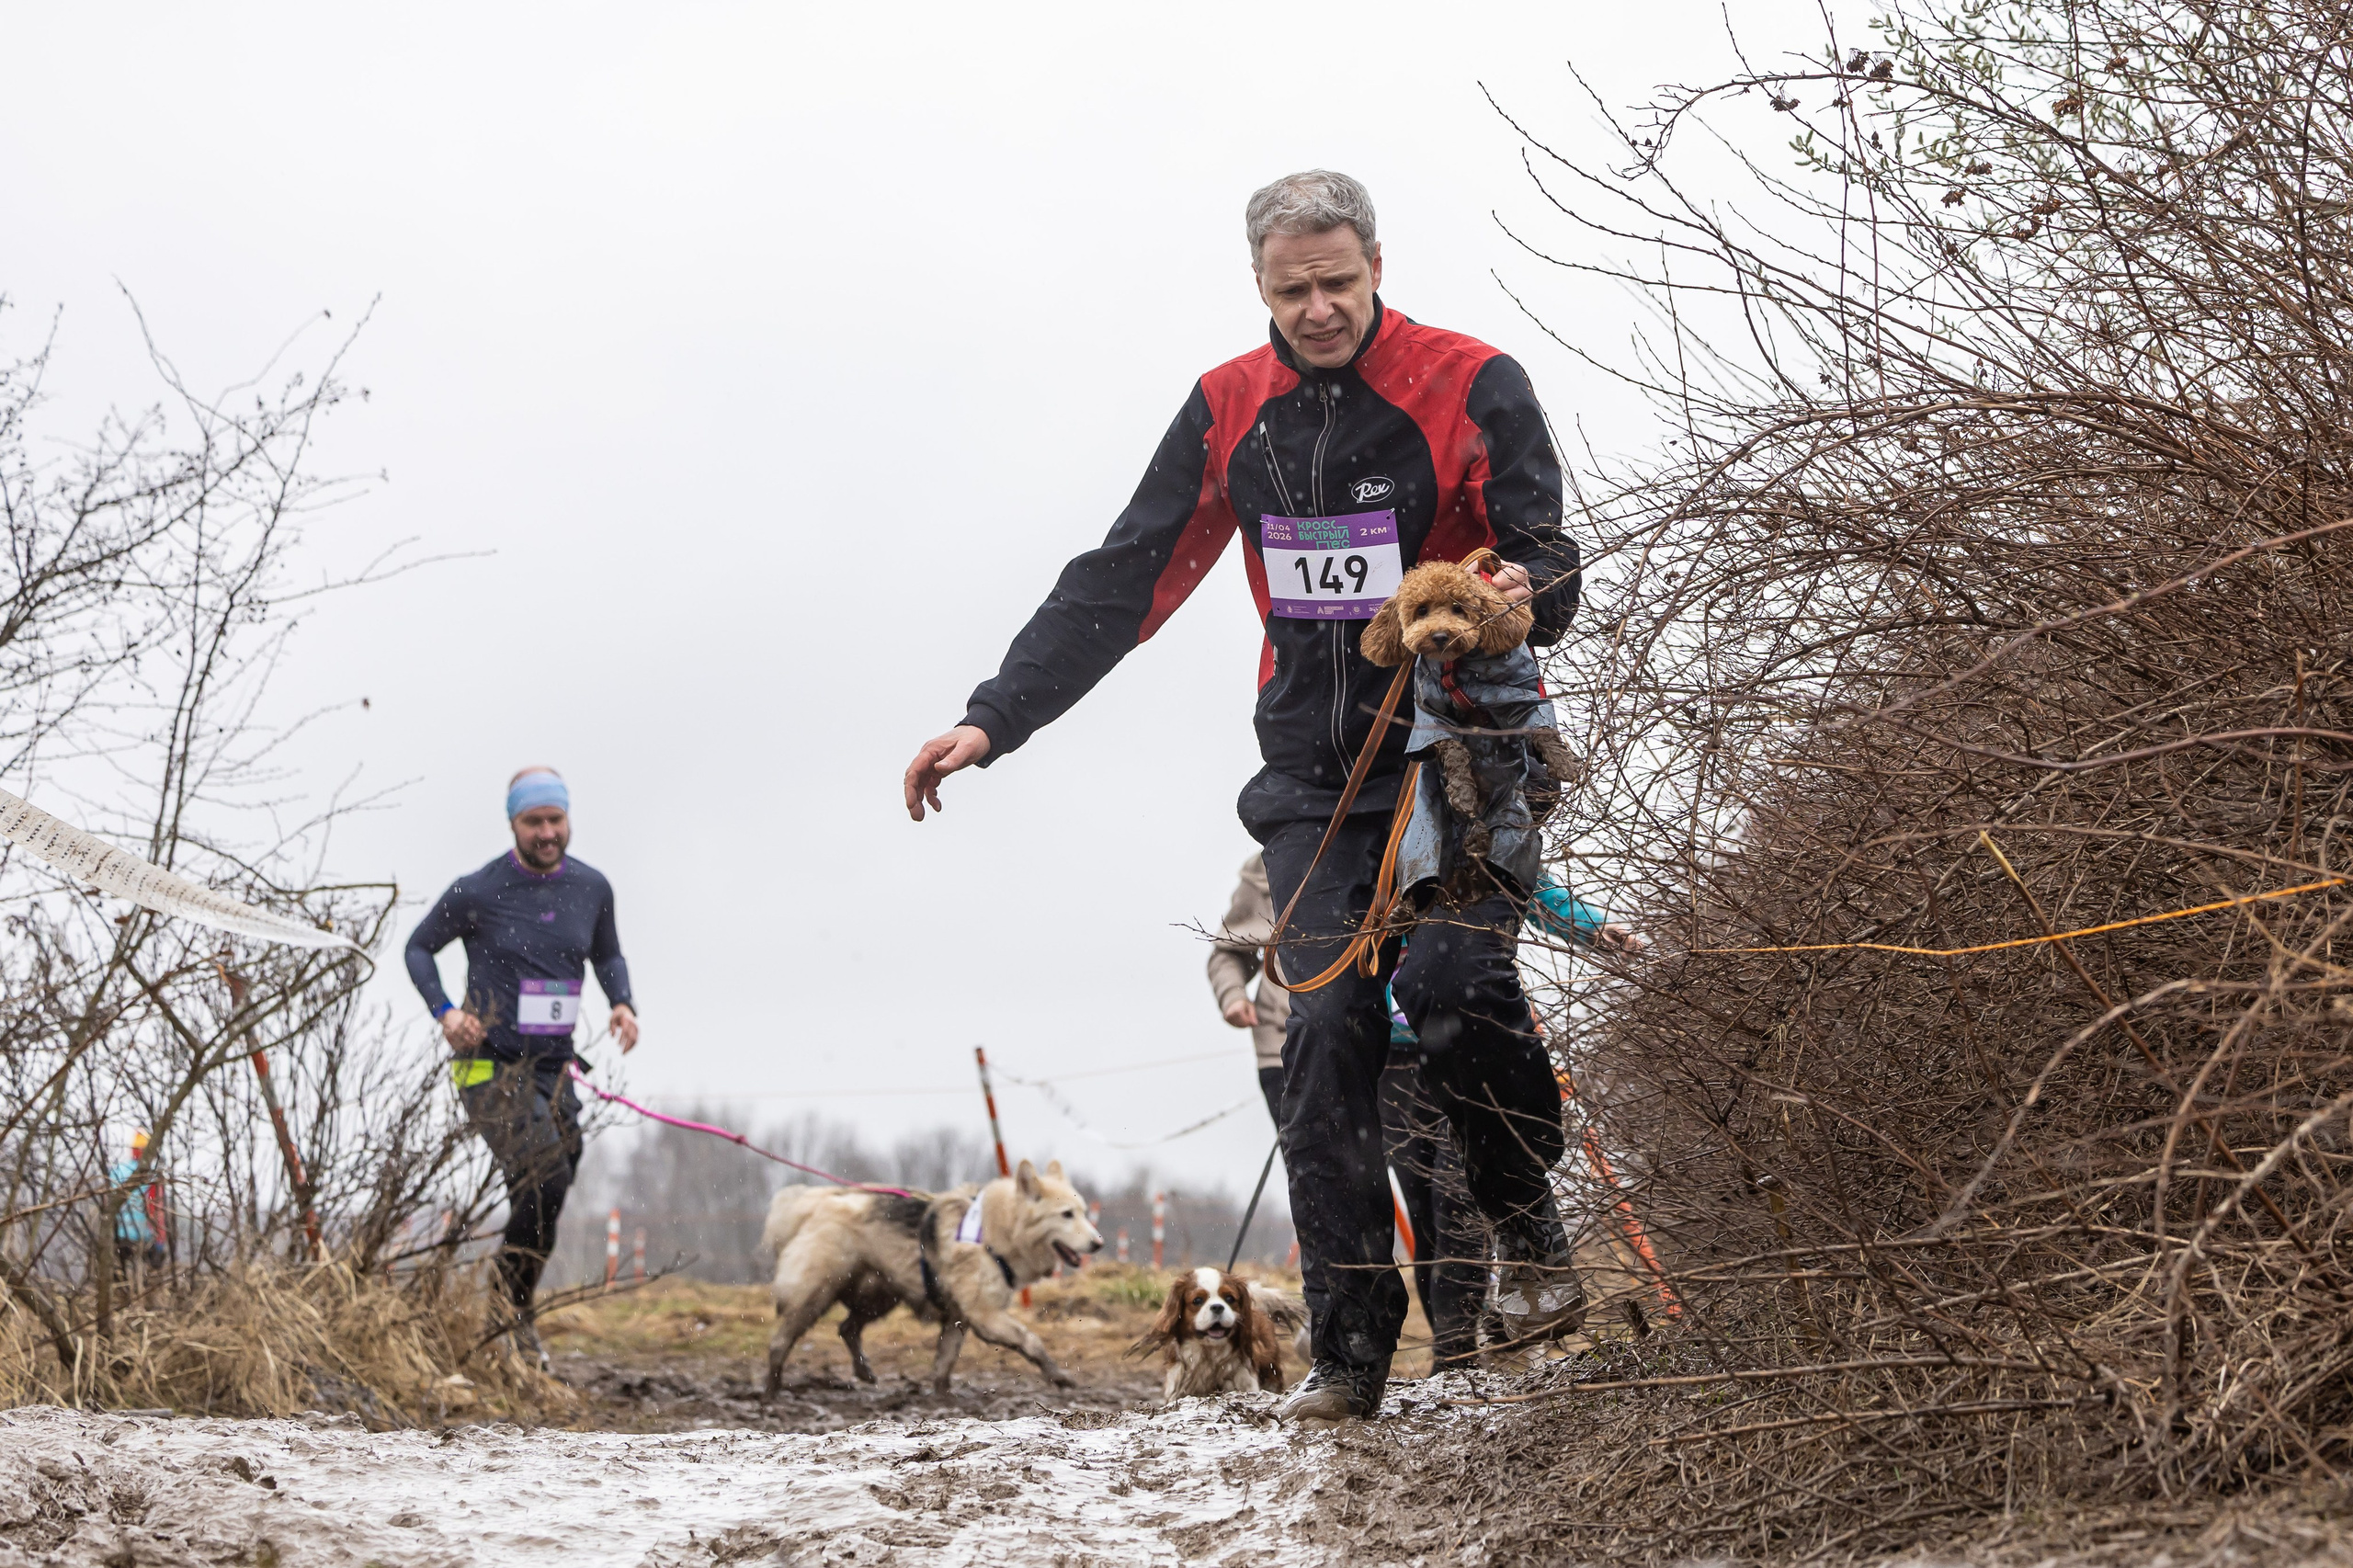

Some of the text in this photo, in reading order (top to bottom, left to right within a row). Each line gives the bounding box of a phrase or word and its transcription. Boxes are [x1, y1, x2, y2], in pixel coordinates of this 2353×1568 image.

[1356, 482, 1390, 503] Rex
[1297, 520, 1337, 530] КРОСС
[1360, 528, 1368, 536] 2
[1267, 531, 1292, 540] 2026
[1294, 554, 1369, 594] 149
[551, 1000, 563, 1021] 8
